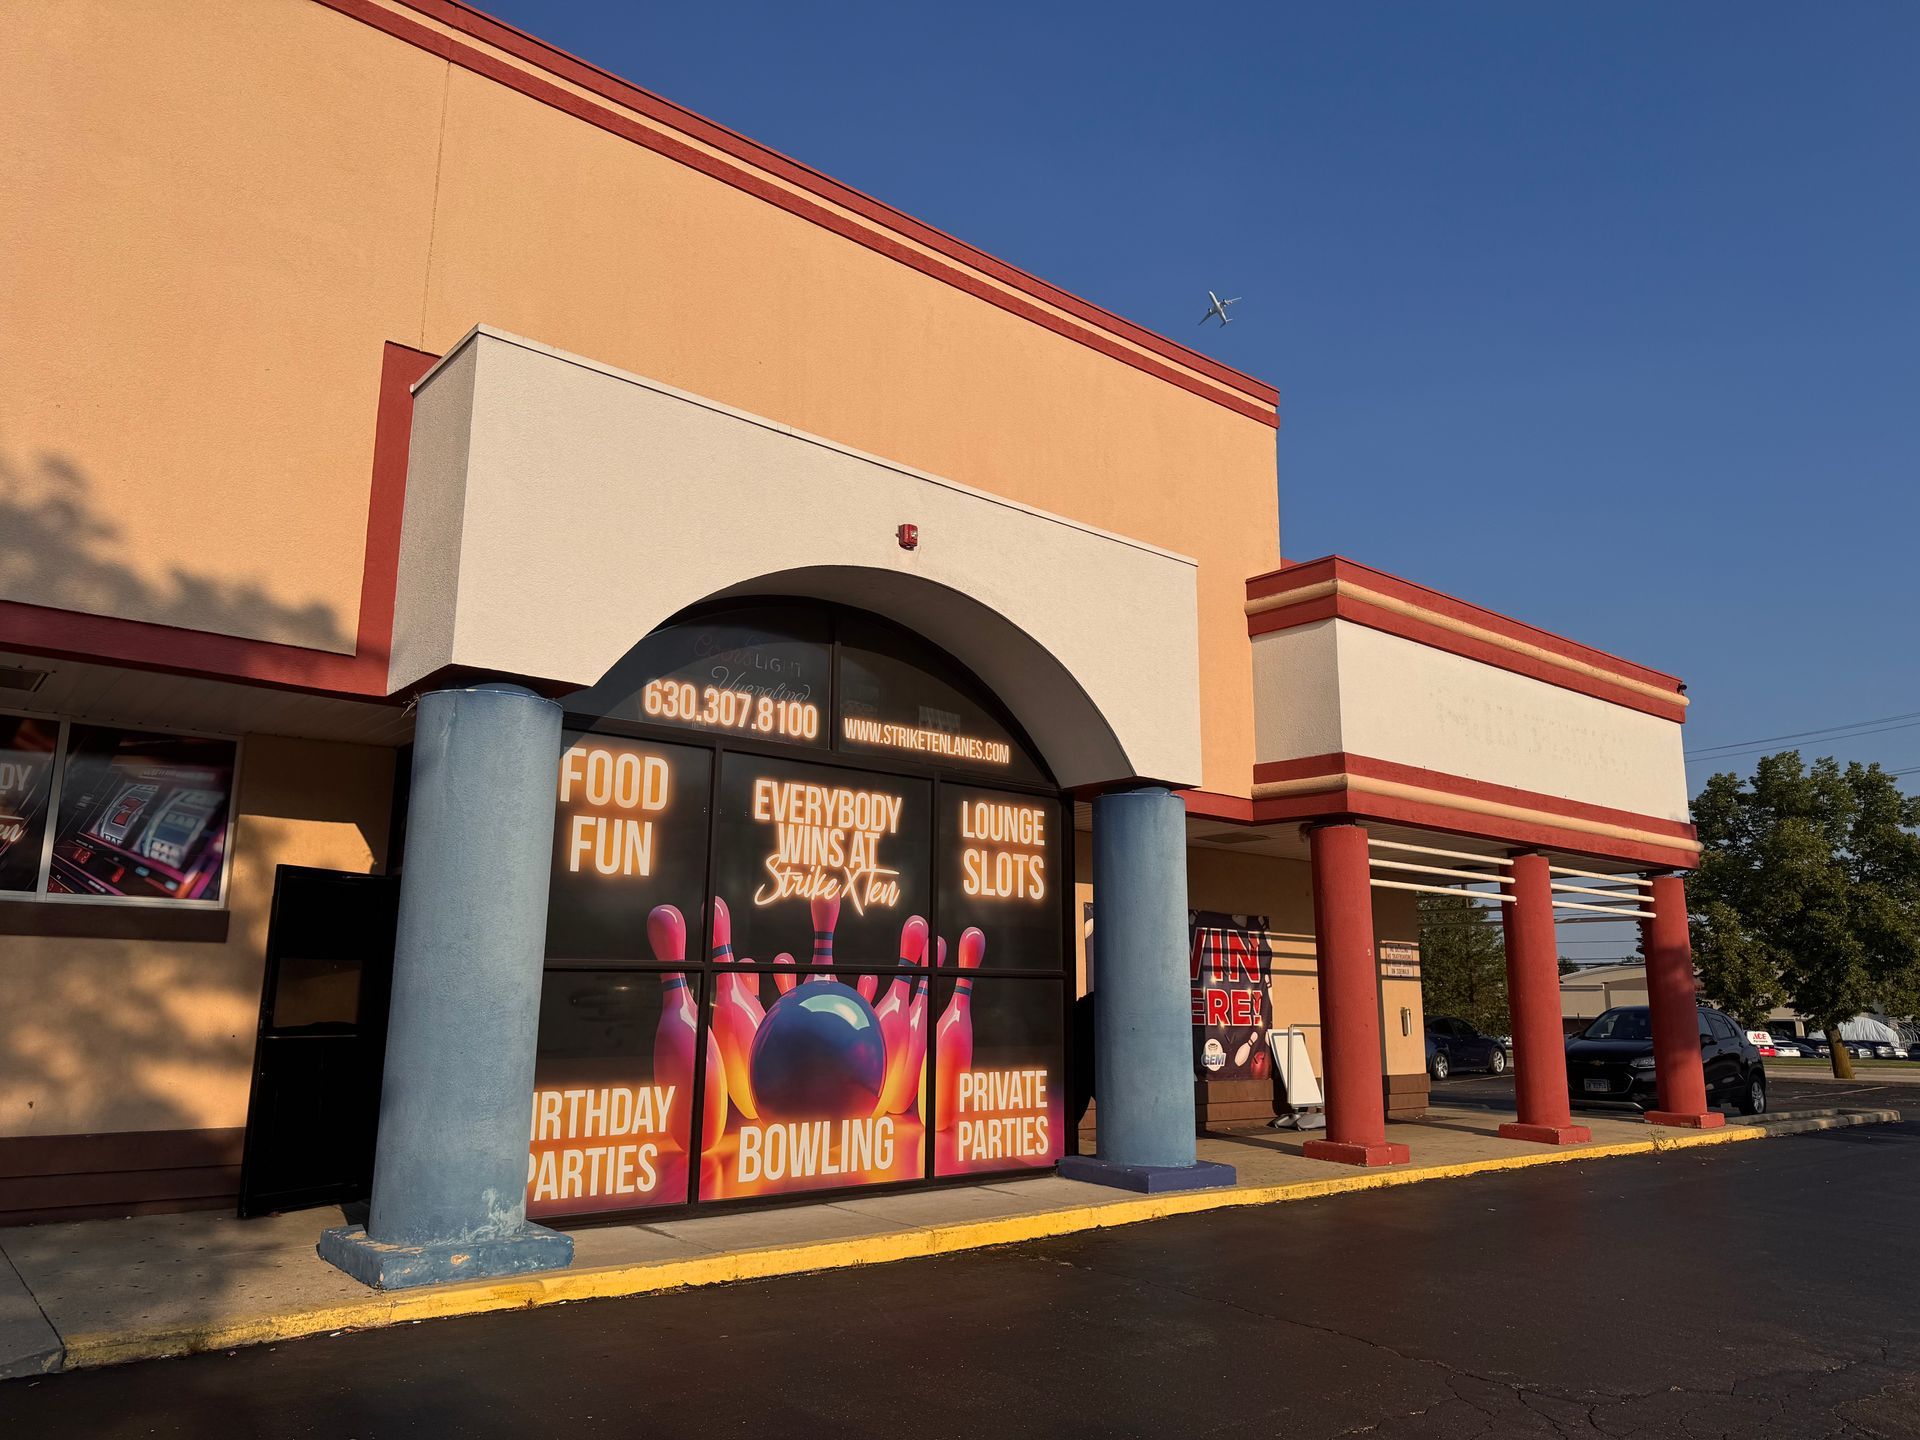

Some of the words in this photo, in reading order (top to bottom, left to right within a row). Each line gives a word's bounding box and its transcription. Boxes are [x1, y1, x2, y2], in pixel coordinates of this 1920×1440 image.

[644, 679, 819, 740] 630.307.8100
[844, 716, 1010, 764] WWW.STRIKETENLANES.COM
[559, 746, 669, 810] FOOD
[753, 779, 902, 834] EVERYBODY
[961, 800, 1046, 847] LOUNGE
[569, 815, 653, 876] FUN
[777, 823, 846, 867] WINS
[849, 830, 880, 869] AT
[754, 853, 841, 906] Strike
[962, 849, 1045, 900] SLOTS
[1191, 988, 1263, 1026] ERE!
[1202, 1054, 1225, 1067] GEM
[529, 1085, 677, 1143] IRTHDAY
[958, 1070, 1048, 1112] PRIVATE
[737, 1116, 894, 1183] BOWLING
[957, 1116, 1049, 1162] PARTIES
